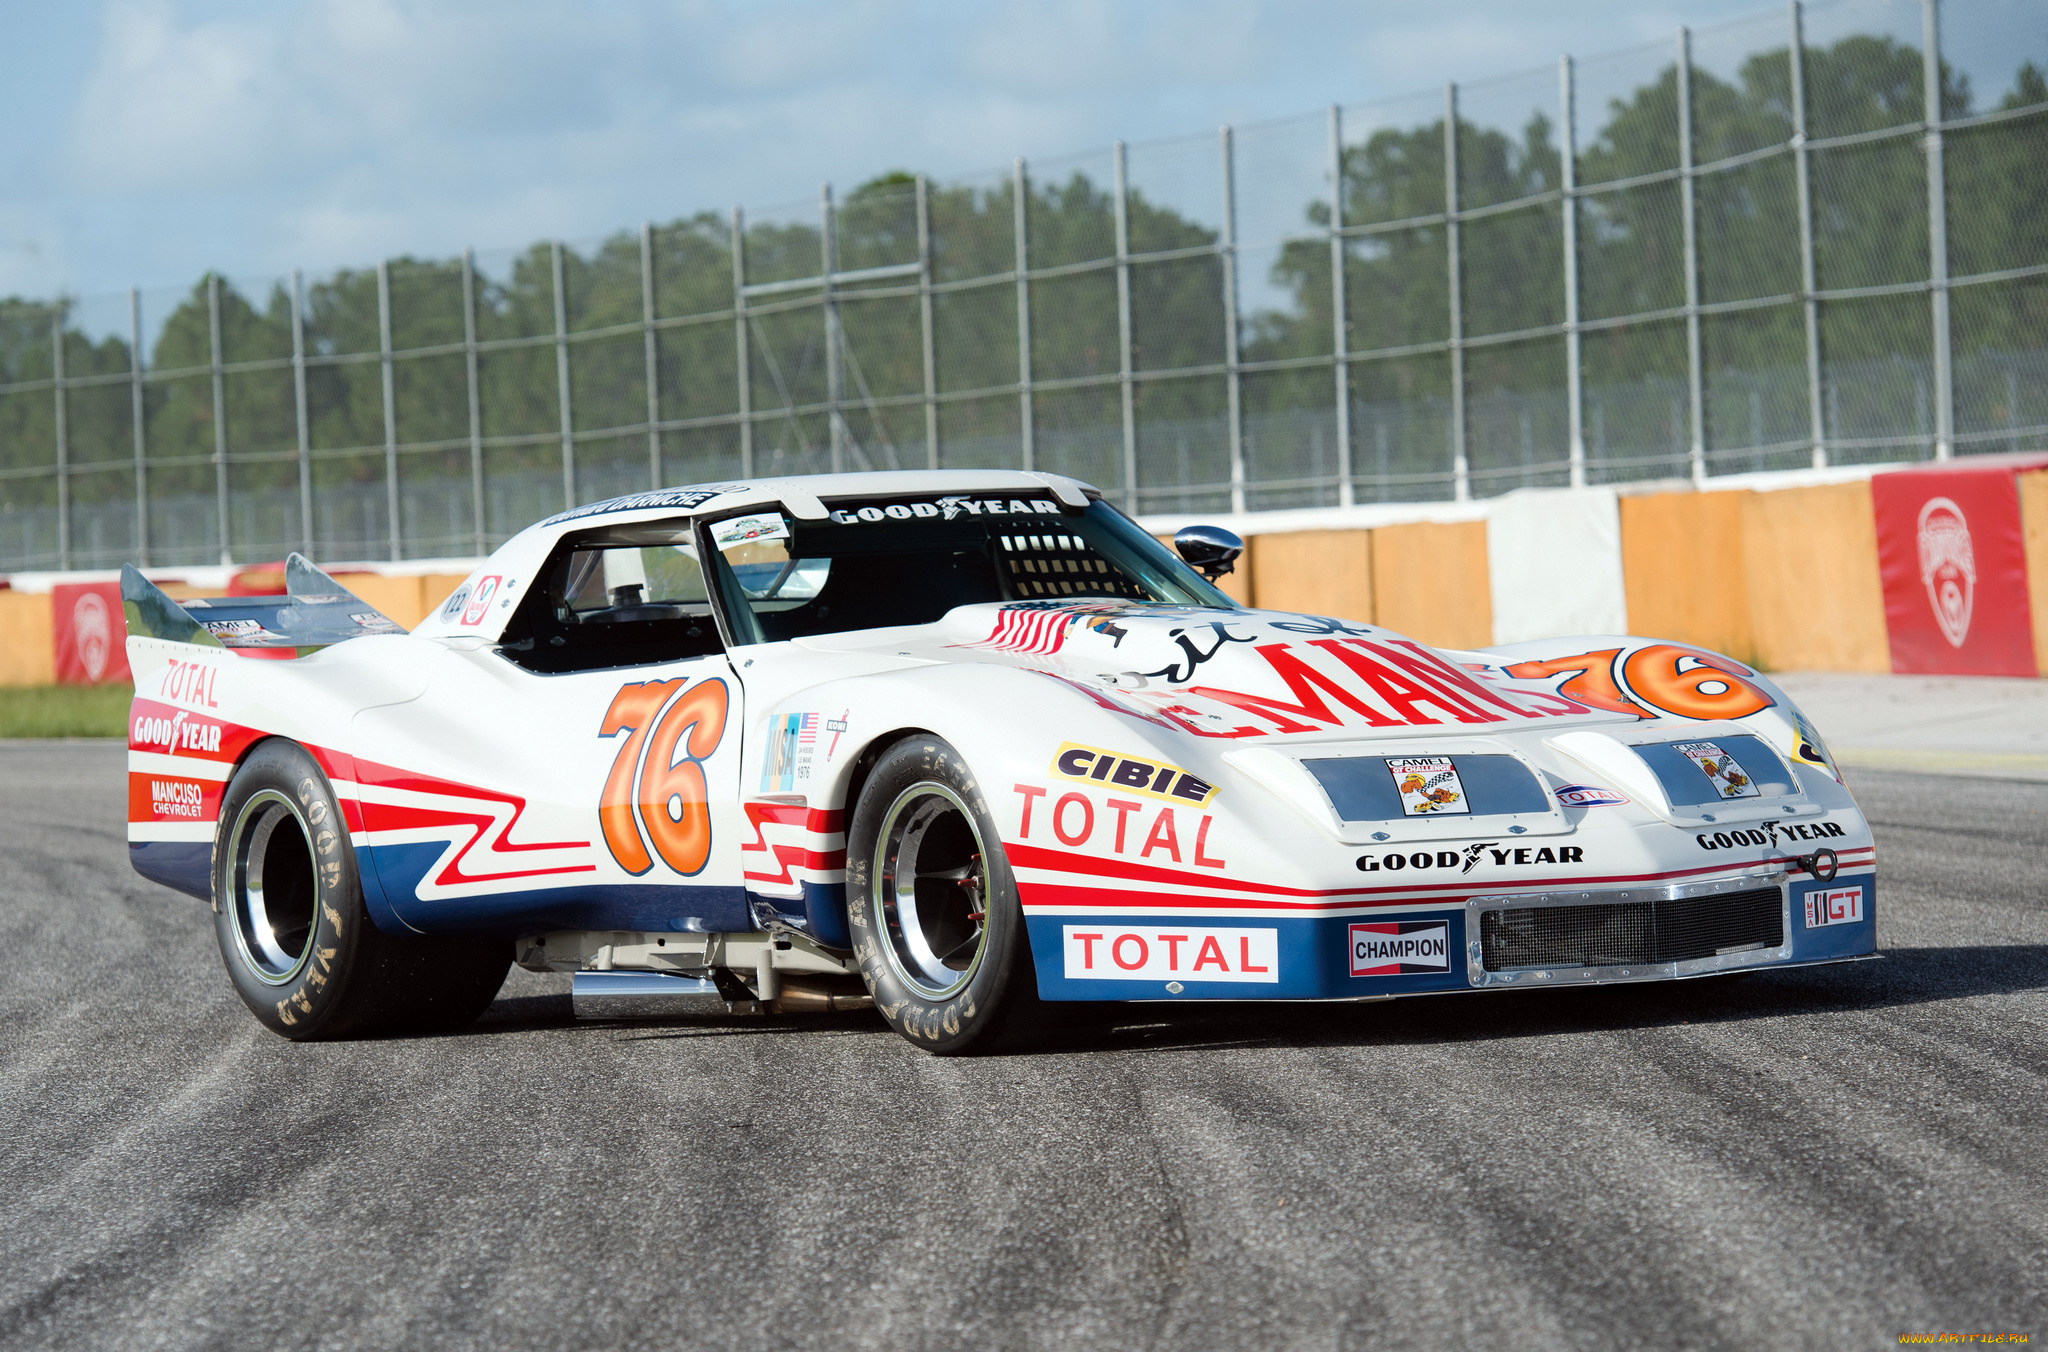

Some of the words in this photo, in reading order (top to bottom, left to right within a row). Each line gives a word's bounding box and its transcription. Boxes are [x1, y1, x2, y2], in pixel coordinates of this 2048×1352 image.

[161, 658, 217, 708] TOTAL
[1500, 644, 1778, 721] 76
[827, 720, 847, 732] KONI
[798, 766, 810, 779] 1976
[1389, 758, 1450, 766] CAMEL
[598, 677, 729, 877] 76
[152, 781, 202, 805] MANCUSO
[1556, 791, 1625, 803] TOTAL
[153, 802, 202, 817] CHEVROLET
[1013, 783, 1225, 869] TOTAL
[1829, 891, 1860, 919] GT
[1073, 933, 1268, 973] TOTAL
[1356, 939, 1444, 959] CHAMPION
